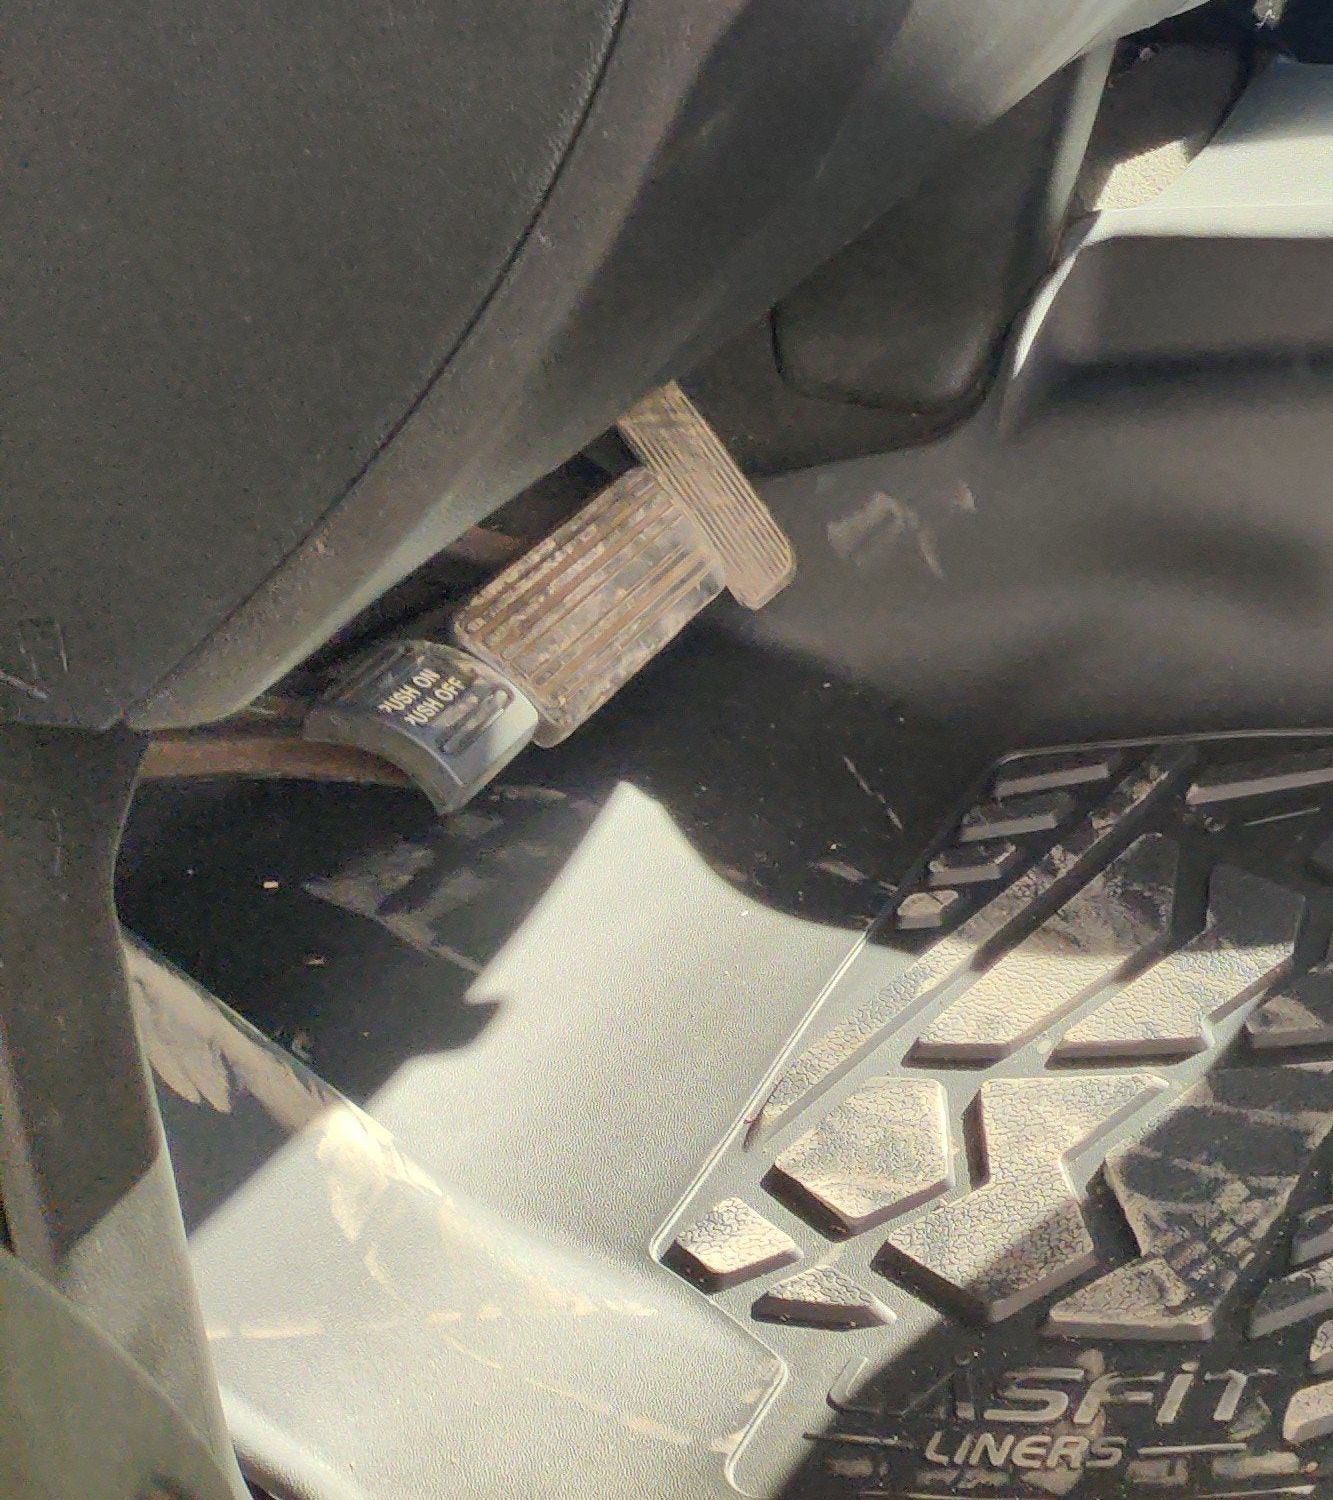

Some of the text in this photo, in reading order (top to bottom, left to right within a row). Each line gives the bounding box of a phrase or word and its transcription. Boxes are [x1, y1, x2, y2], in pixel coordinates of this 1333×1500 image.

[412, 668, 441, 688] ON
[434, 676, 465, 701] OFF
[924, 1430, 1128, 1469] LINERS
